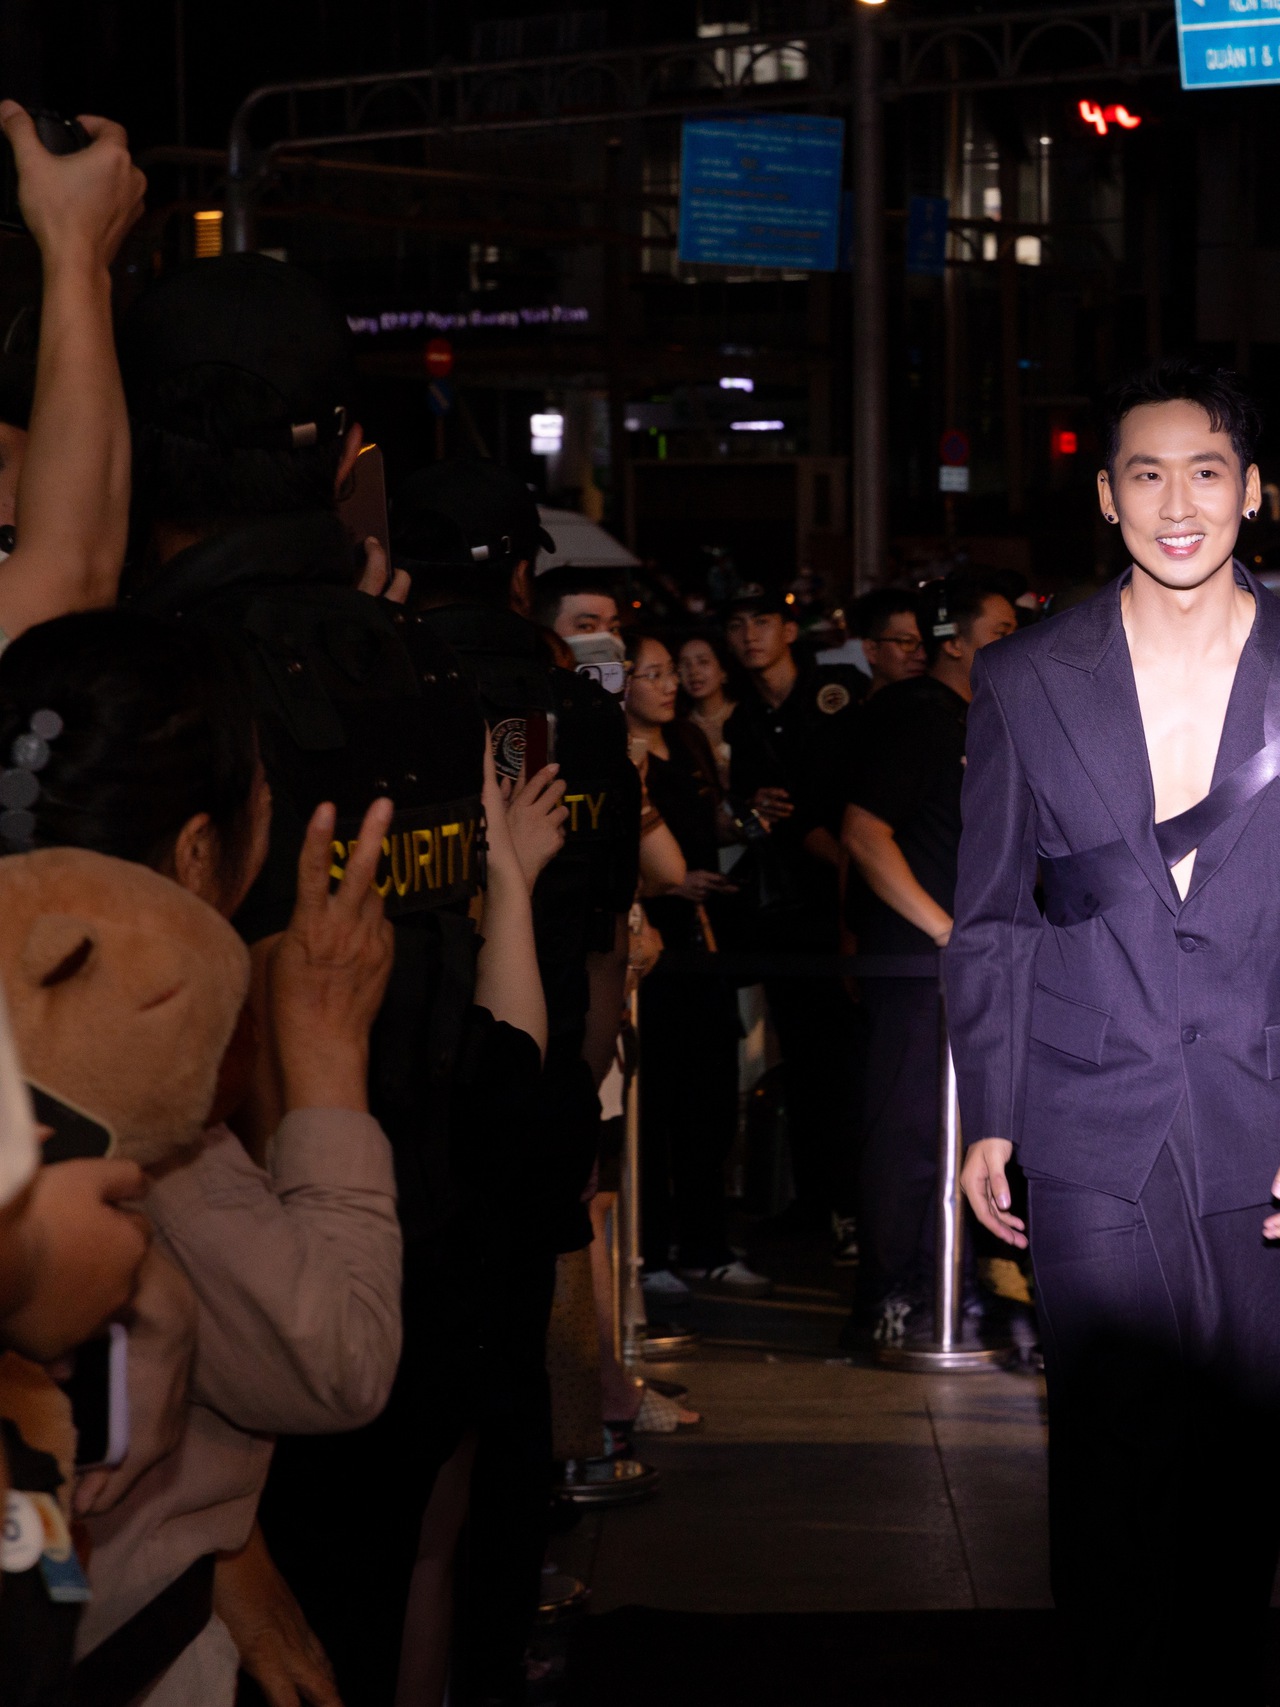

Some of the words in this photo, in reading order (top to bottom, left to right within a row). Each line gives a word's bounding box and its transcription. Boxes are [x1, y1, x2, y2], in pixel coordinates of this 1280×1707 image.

[1249, 46, 1256, 67] 1
[1261, 45, 1273, 67] &
[560, 791, 608, 832] TY
[329, 819, 475, 896] SCURITY
